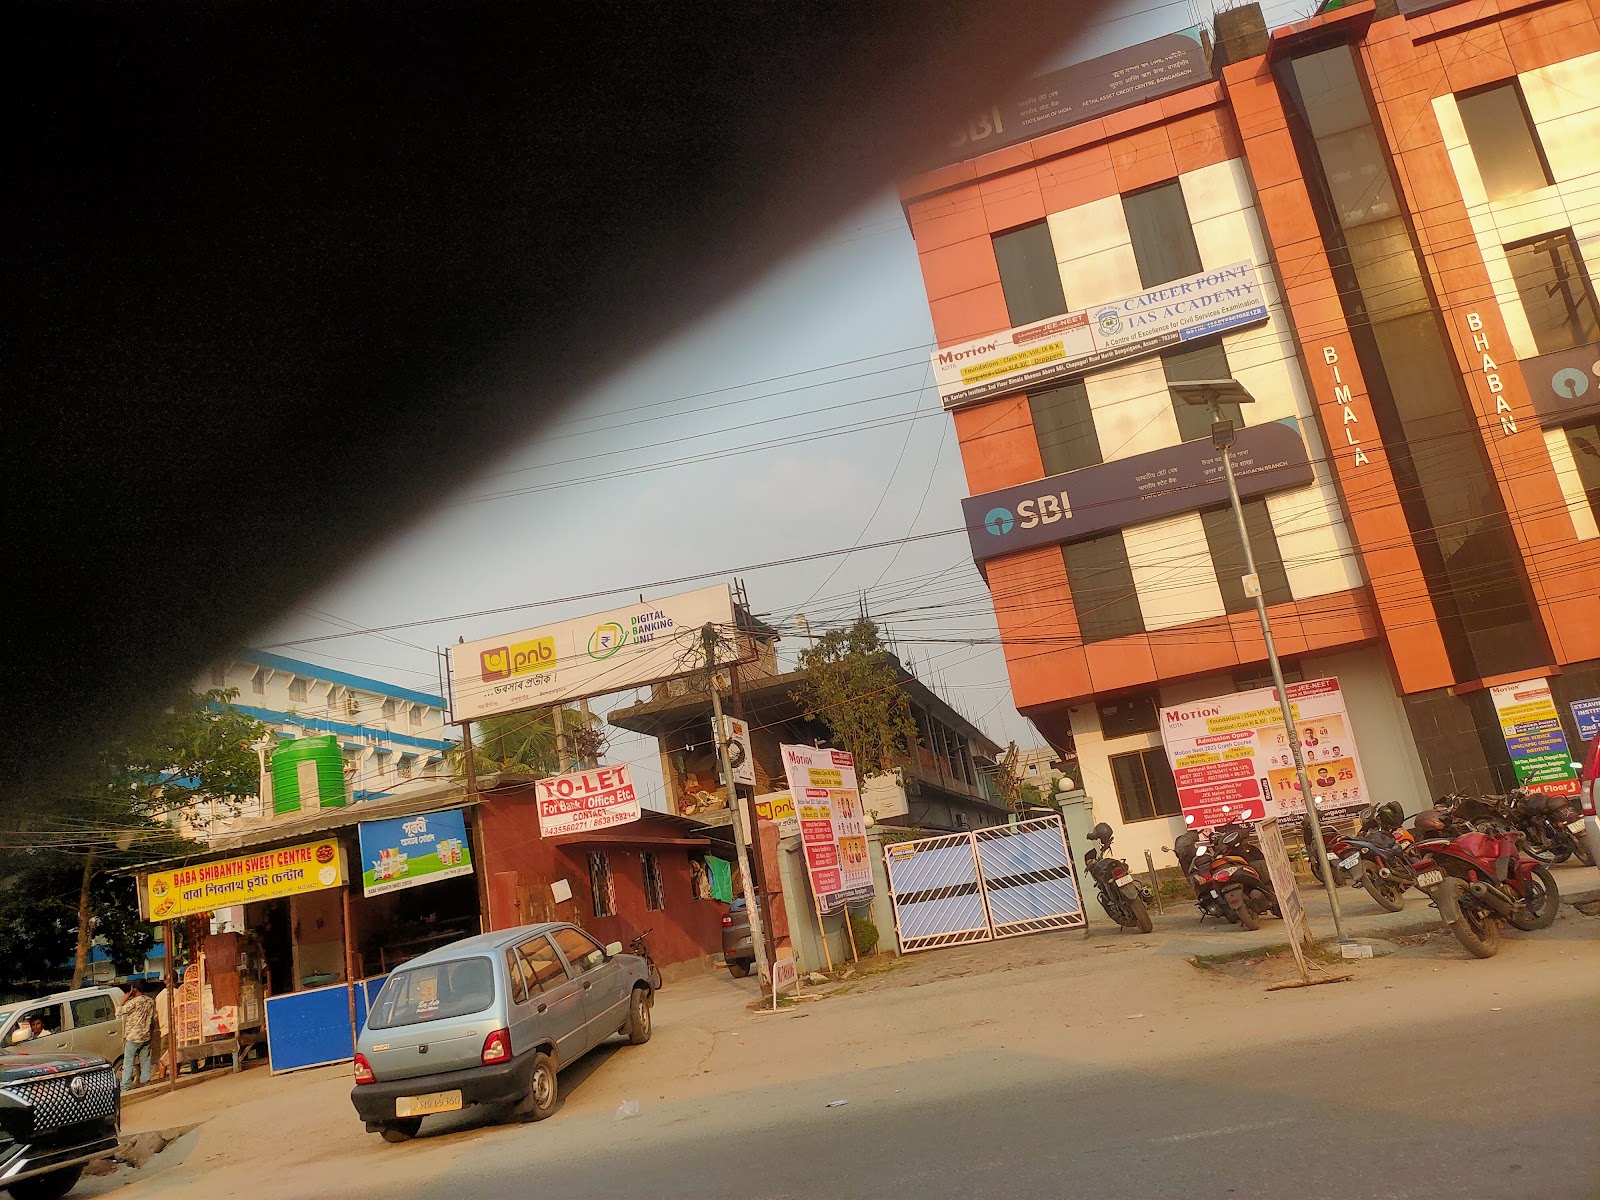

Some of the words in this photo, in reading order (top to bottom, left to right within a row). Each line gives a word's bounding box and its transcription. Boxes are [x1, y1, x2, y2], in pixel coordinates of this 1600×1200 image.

[1099, 92, 1115, 101] ASSET
[1115, 86, 1133, 96] CREDIT
[1156, 68, 1192, 83] BONGAIGAON
[1021, 117, 1036, 125] STATE
[1036, 112, 1050, 121] BANK
[1057, 106, 1072, 114] INDIA
[1122, 281, 1191, 312] CAREER
[1196, 264, 1248, 289] POINT
[1127, 309, 1157, 328] IAS
[1161, 281, 1254, 318] ACADEMY
[1042, 314, 1082, 330] JEE-NEET
[1109, 334, 1130, 345] Centre
[1137, 323, 1169, 337] Excellence
[1170, 320, 1179, 328] for
[1179, 315, 1193, 325] Civil
[1194, 308, 1220, 321] Services
[1220, 297, 1259, 313] Examination
[964, 359, 999, 374] Foundations
[1003, 354, 1017, 363] Class
[1033, 351, 1062, 365] Droppers
[950, 391, 968, 400] Xavier's
[996, 380, 1008, 388] Floor
[1142, 338, 1158, 347] Assam
[1466, 312, 1518, 436] BHABAN
[1323, 346, 1369, 467] BIMALA
[1264, 459, 1288, 471] BRANCH
[1015, 489, 1073, 531] SBI
[630, 610, 665, 625] DIGITAL
[632, 618, 673, 635] BANKING
[634, 633, 655, 645] UNIT
[514, 642, 552, 668] pnb
[1297, 680, 1330, 692] JEE-NEET
[1209, 716, 1241, 725] Foundations
[1197, 734, 1230, 745] Admission
[1231, 731, 1249, 740] Open
[1276, 735, 1284, 743] 27
[1319, 728, 1328, 736] 49
[1174, 748, 1190, 756] Motion
[1191, 746, 1203, 754] Neet
[1233, 740, 1252, 748] Course
[542, 767, 626, 798] TO-LET
[1337, 769, 1353, 781] 25
[1277, 780, 1291, 790] 11
[1544, 784, 1567, 792] Floor
[543, 802, 559, 815] For
[560, 800, 581, 812] Bank
[587, 795, 615, 809] Office
[617, 790, 634, 802] Etc.
[573, 809, 607, 821] CONTACT
[171, 870, 197, 887] BABA
[198, 860, 243, 882] SHIBANTH
[244, 854, 275, 873] SWEET
[276, 847, 312, 867] CENTRE
